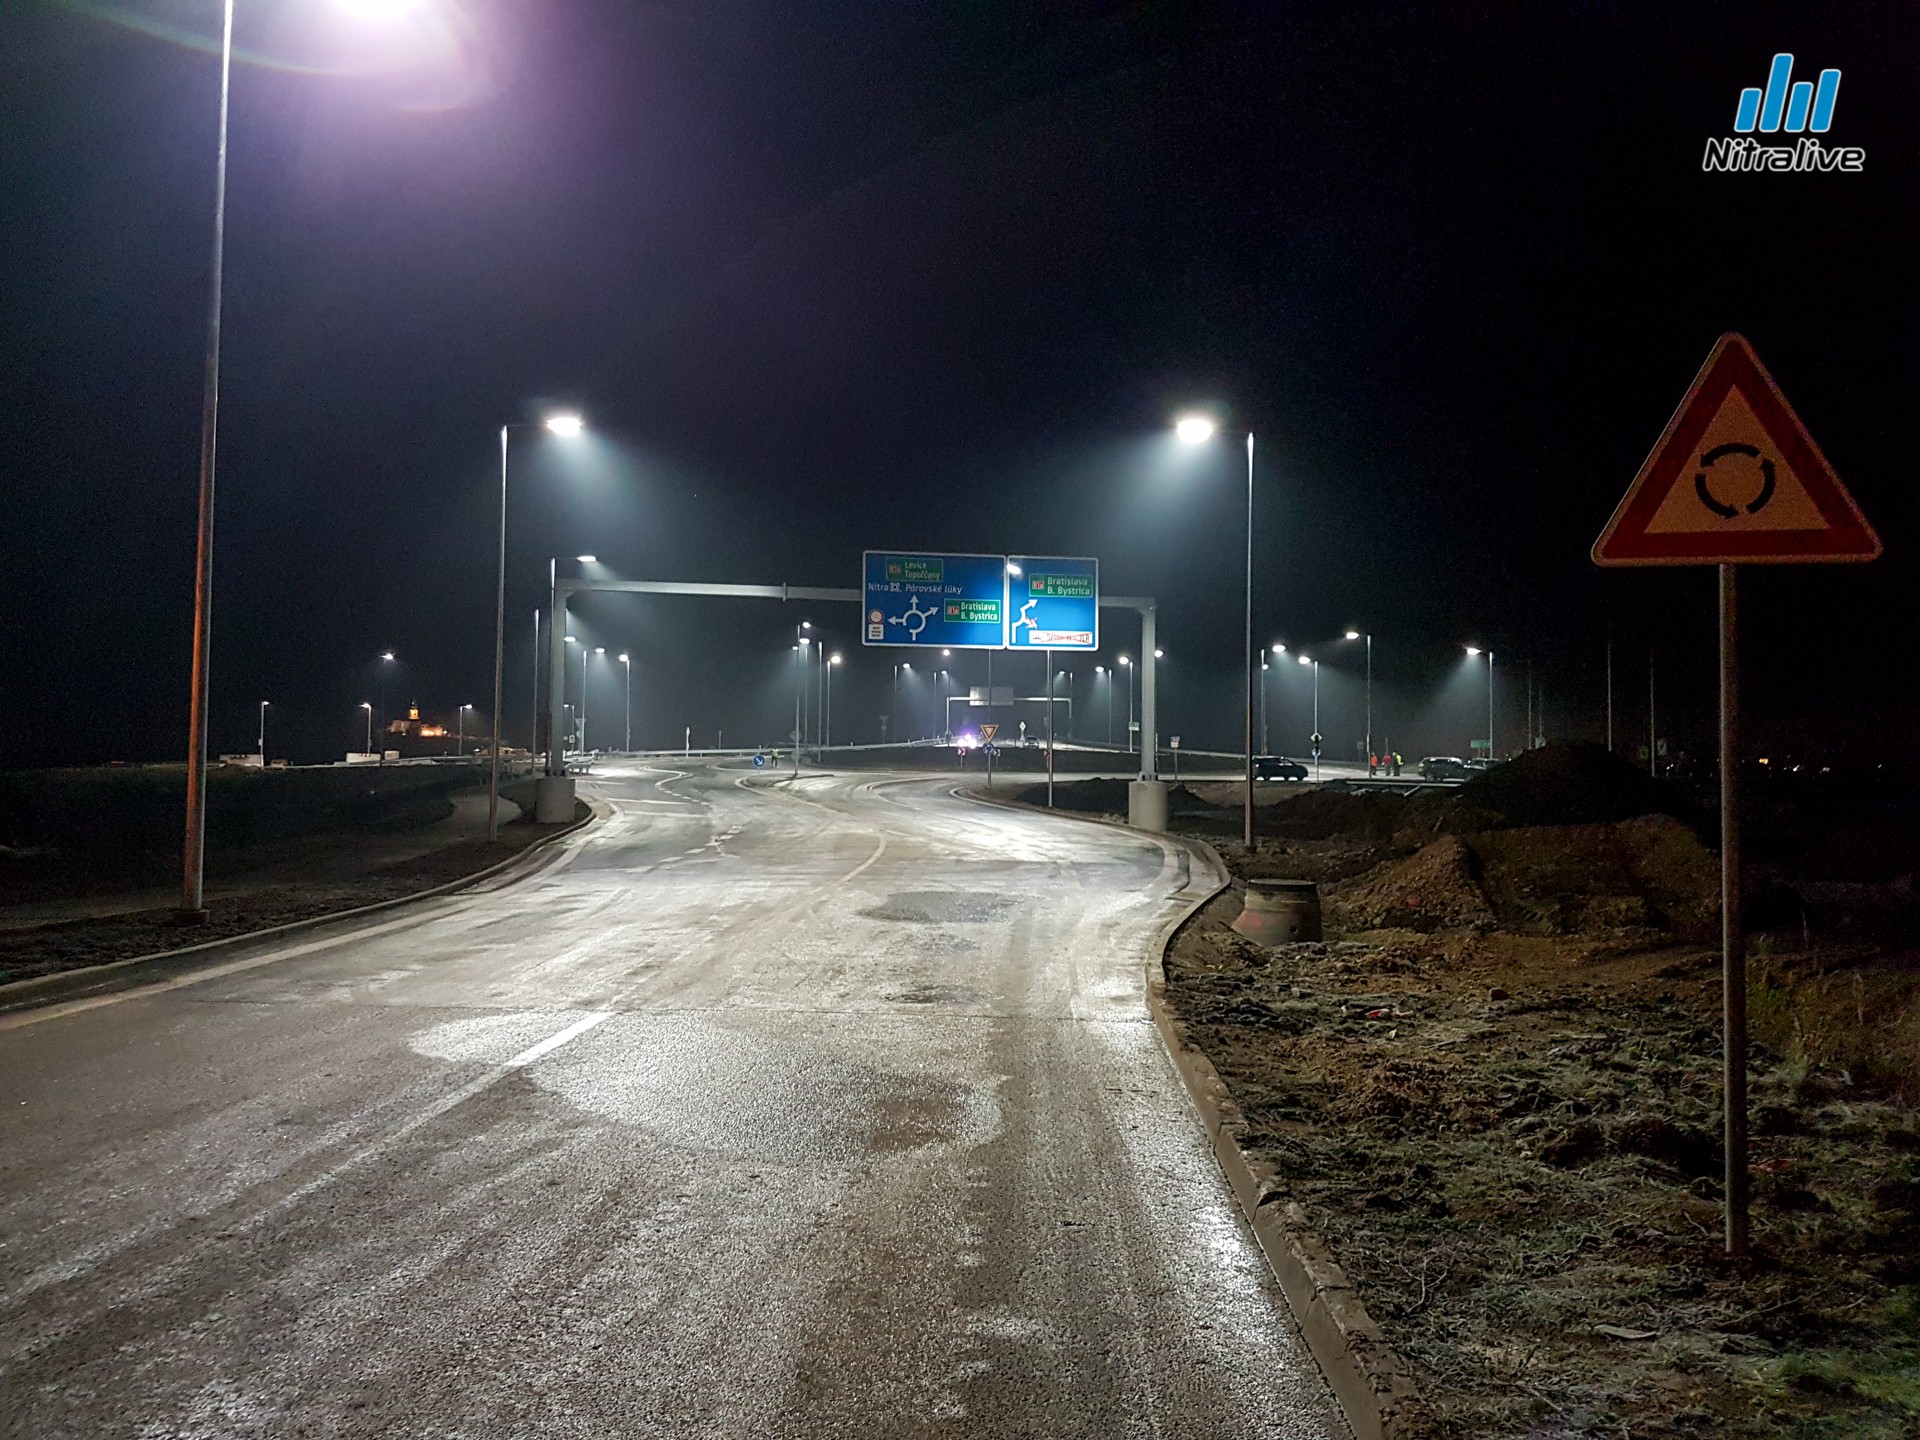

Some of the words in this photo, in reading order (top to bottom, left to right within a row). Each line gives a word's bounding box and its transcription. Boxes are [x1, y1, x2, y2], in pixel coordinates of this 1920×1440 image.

[904, 561, 927, 569] Levice
[1047, 576, 1088, 586] Bratislava
[868, 582, 889, 591] Nitra
[905, 583, 942, 593] Párovské
[944, 584, 963, 594] lúky
[1047, 586, 1055, 595] B.
[1057, 586, 1090, 596] Bystrica
[960, 602, 996, 611] Bratislava
[960, 611, 967, 620] B.
[969, 612, 998, 621] Bystrica
